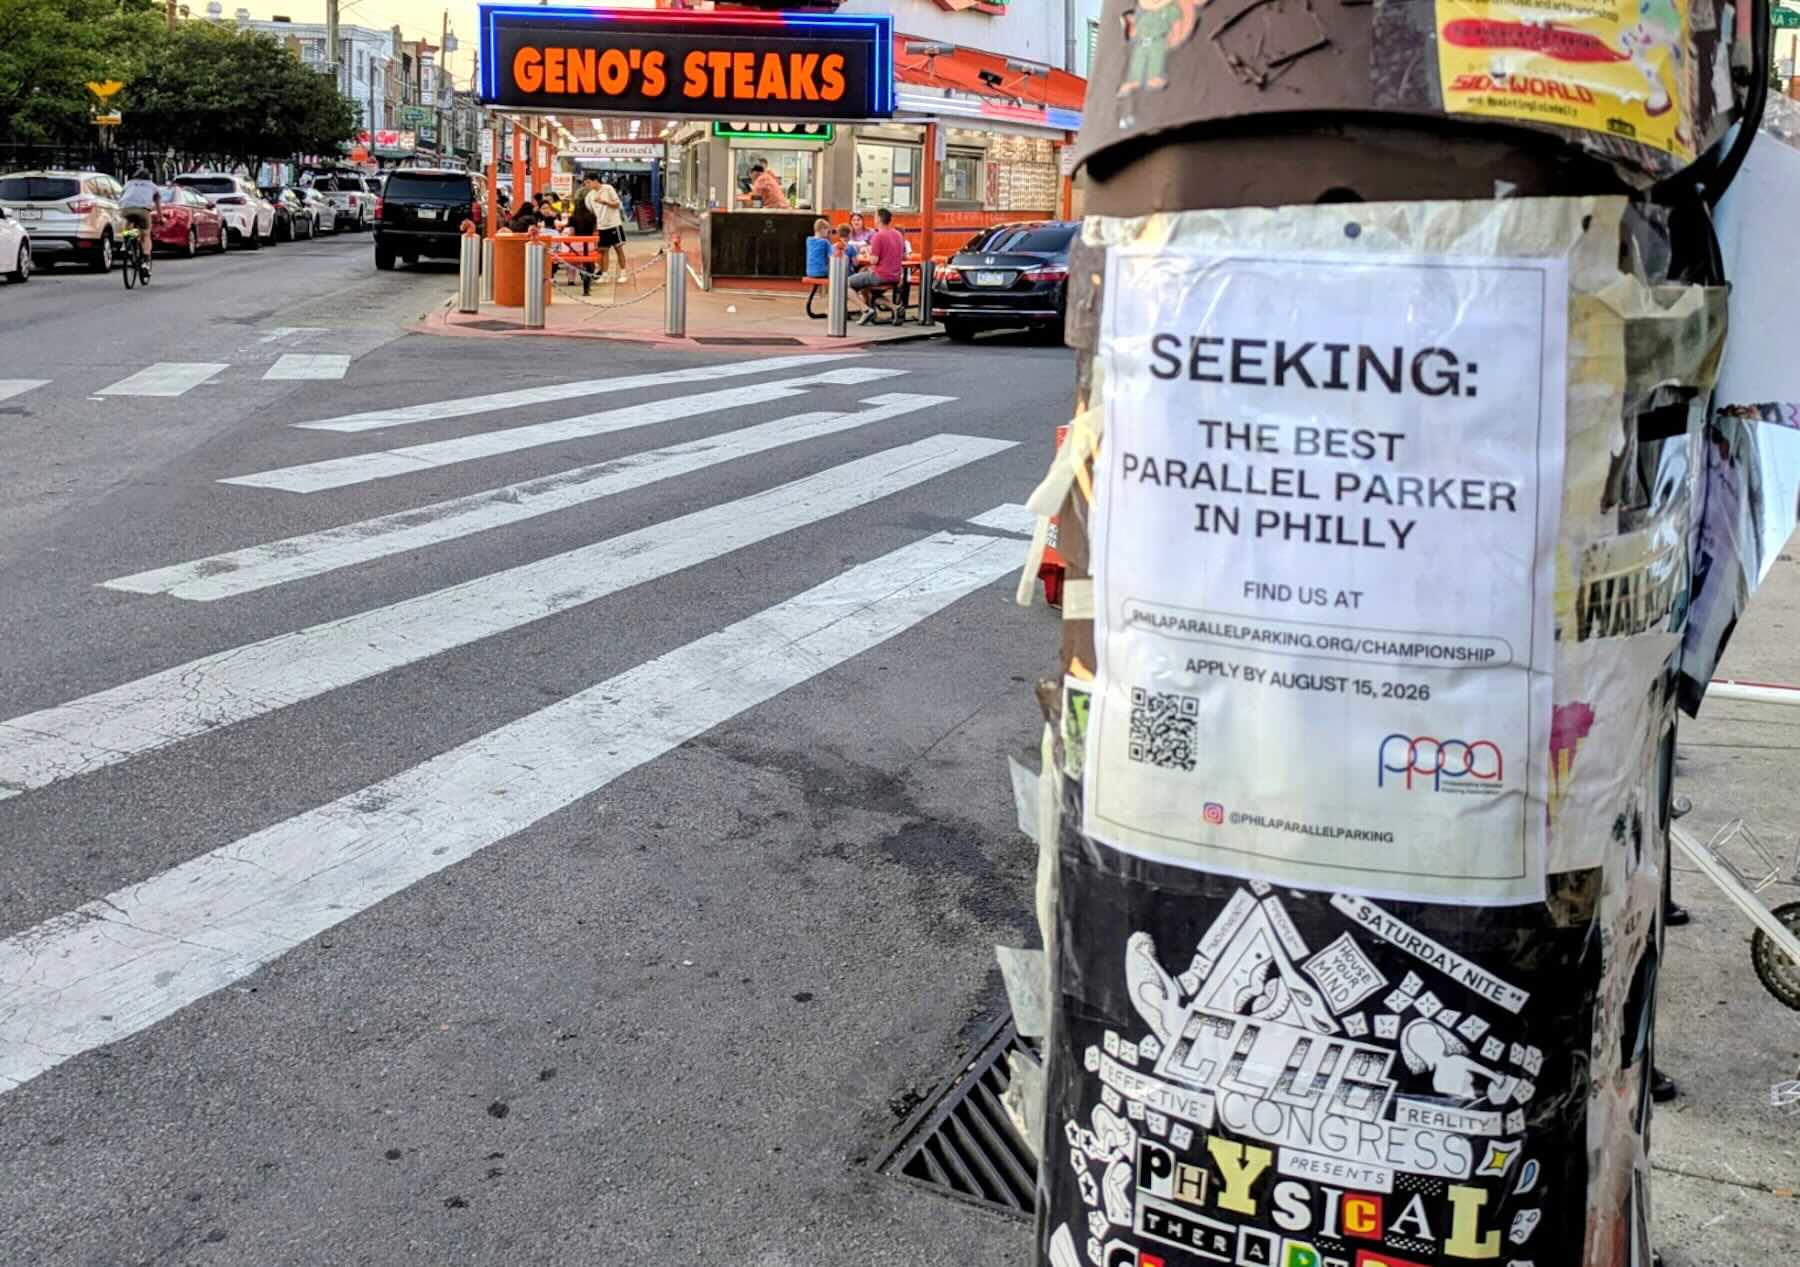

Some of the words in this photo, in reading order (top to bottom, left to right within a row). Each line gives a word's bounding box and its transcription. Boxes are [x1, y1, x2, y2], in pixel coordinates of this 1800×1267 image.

[513, 46, 667, 97] GENO'S
[682, 51, 846, 101] STEAKS
[1149, 333, 1479, 398] SEEKING:
[1198, 420, 1280, 454] THE
[1293, 426, 1405, 462] BEST
[1122, 452, 1320, 500] PARALLEL
[1334, 471, 1519, 513] PARKER
[1194, 503, 1240, 536] IN
[1255, 509, 1416, 550] PHILLY
[1243, 581, 1292, 602] FIND
[1298, 586, 1328, 606] US
[1334, 591, 1364, 609] AT
[1131, 609, 1496, 662] PHILAPARALLELPARKING.ORG/CHAMPIONSHIP
[1184, 658, 1240, 679] APPLY
[1244, 666, 1267, 684] BY
[1269, 671, 1348, 693] AUGUST
[1352, 680, 1378, 699] 15,
[1381, 682, 1431, 701] 2026
[1228, 812, 1395, 843] @PHILAPARALLELPARKING
[1313, 960, 1350, 1003] MIND
[1332, 956, 1359, 989] YOUR
[1340, 945, 1373, 985] HOUSE
[1165, 1010, 1398, 1122] CLUB
[1222, 1090, 1468, 1176] CONGRESS
[1289, 1156, 1386, 1185] PRESENTS
[1138, 1135, 1501, 1260] PHYSICAL
